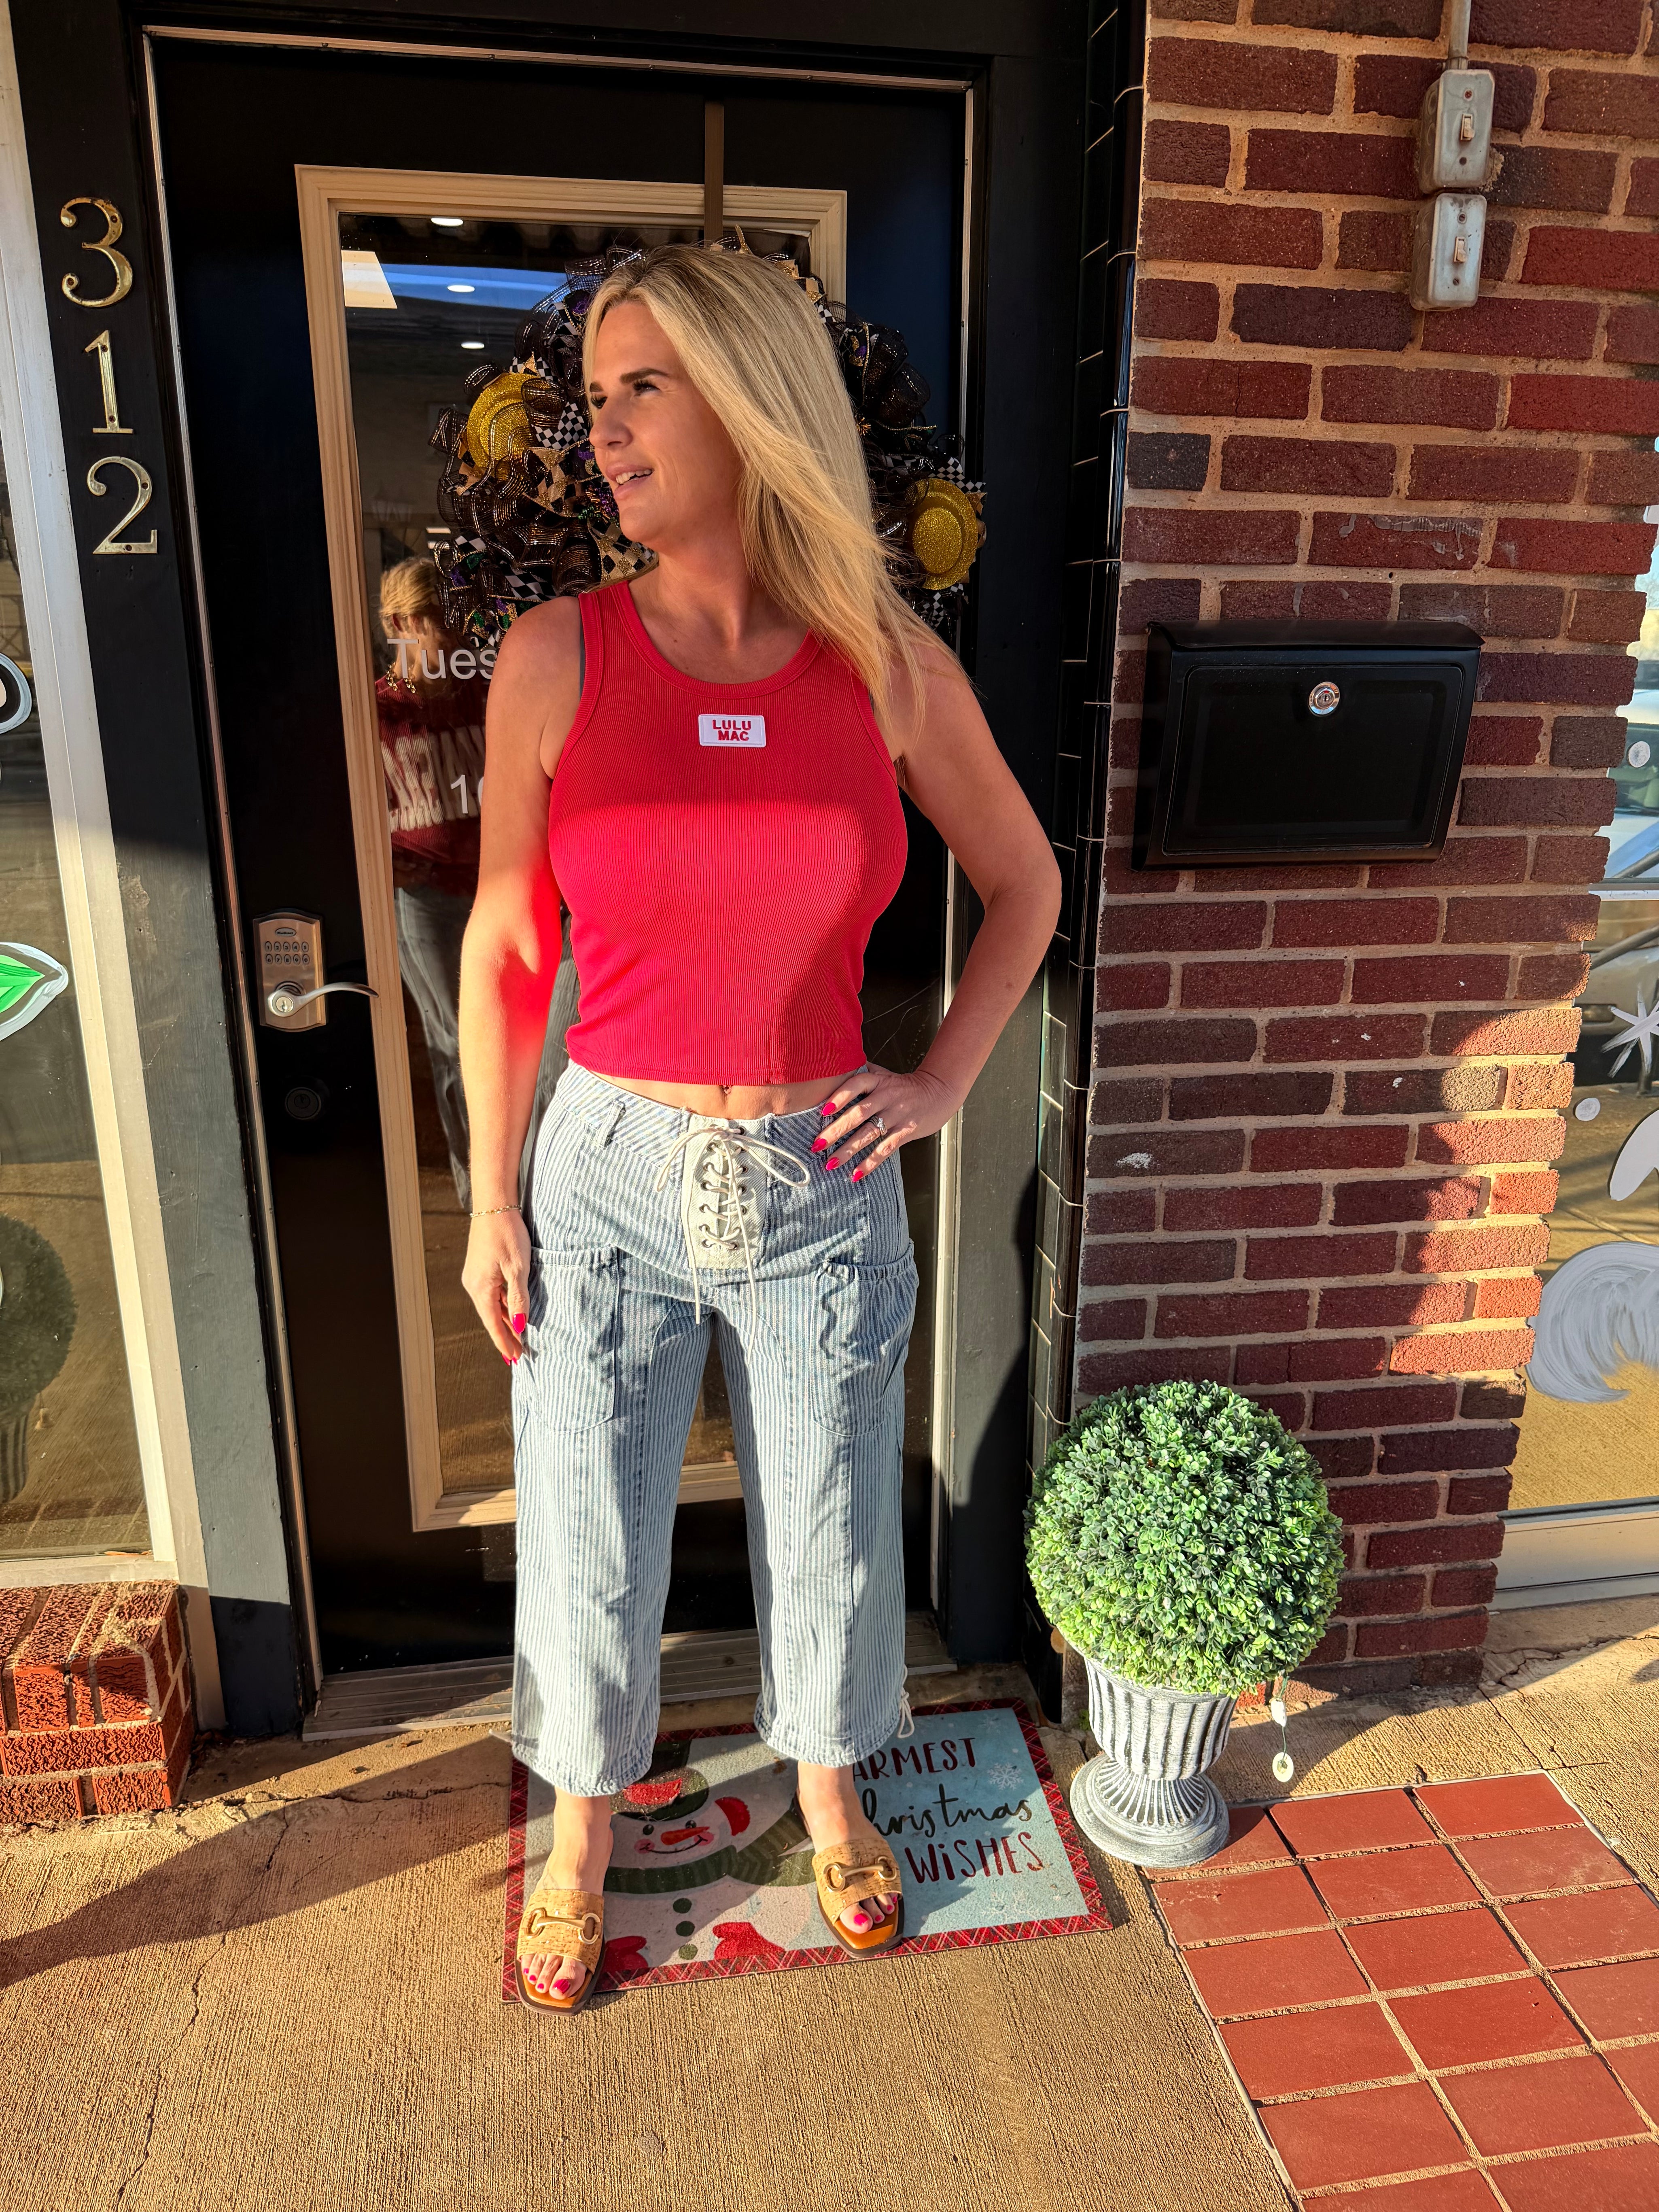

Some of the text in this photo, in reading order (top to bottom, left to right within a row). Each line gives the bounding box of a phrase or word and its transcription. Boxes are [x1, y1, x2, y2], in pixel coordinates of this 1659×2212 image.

[61, 197, 157, 554] 312
[712, 719, 751, 730] LULU
[718, 730, 749, 741] MAC
[451, 774, 484, 814] 1
[852, 1737, 976, 1781] ARMEST
[862, 1783, 1032, 1838] hristmas
